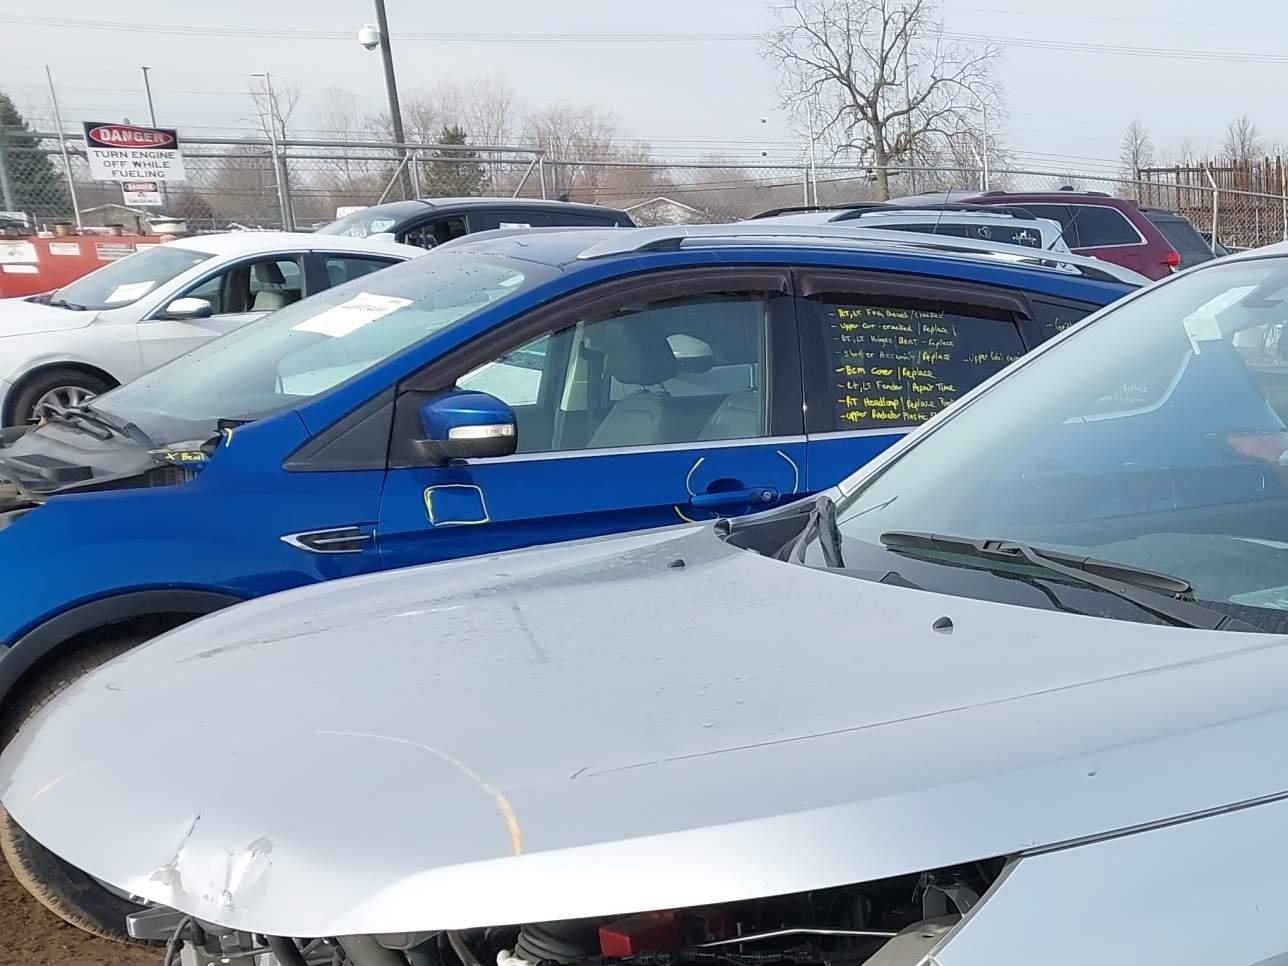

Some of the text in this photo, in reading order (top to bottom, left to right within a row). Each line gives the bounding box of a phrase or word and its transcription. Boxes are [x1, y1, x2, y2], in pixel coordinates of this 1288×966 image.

[100, 128, 164, 143] DANGER
[94, 150, 176, 159] TURN ENGINE
[103, 160, 170, 169] OFF WHILE
[112, 169, 166, 178] FUELING
